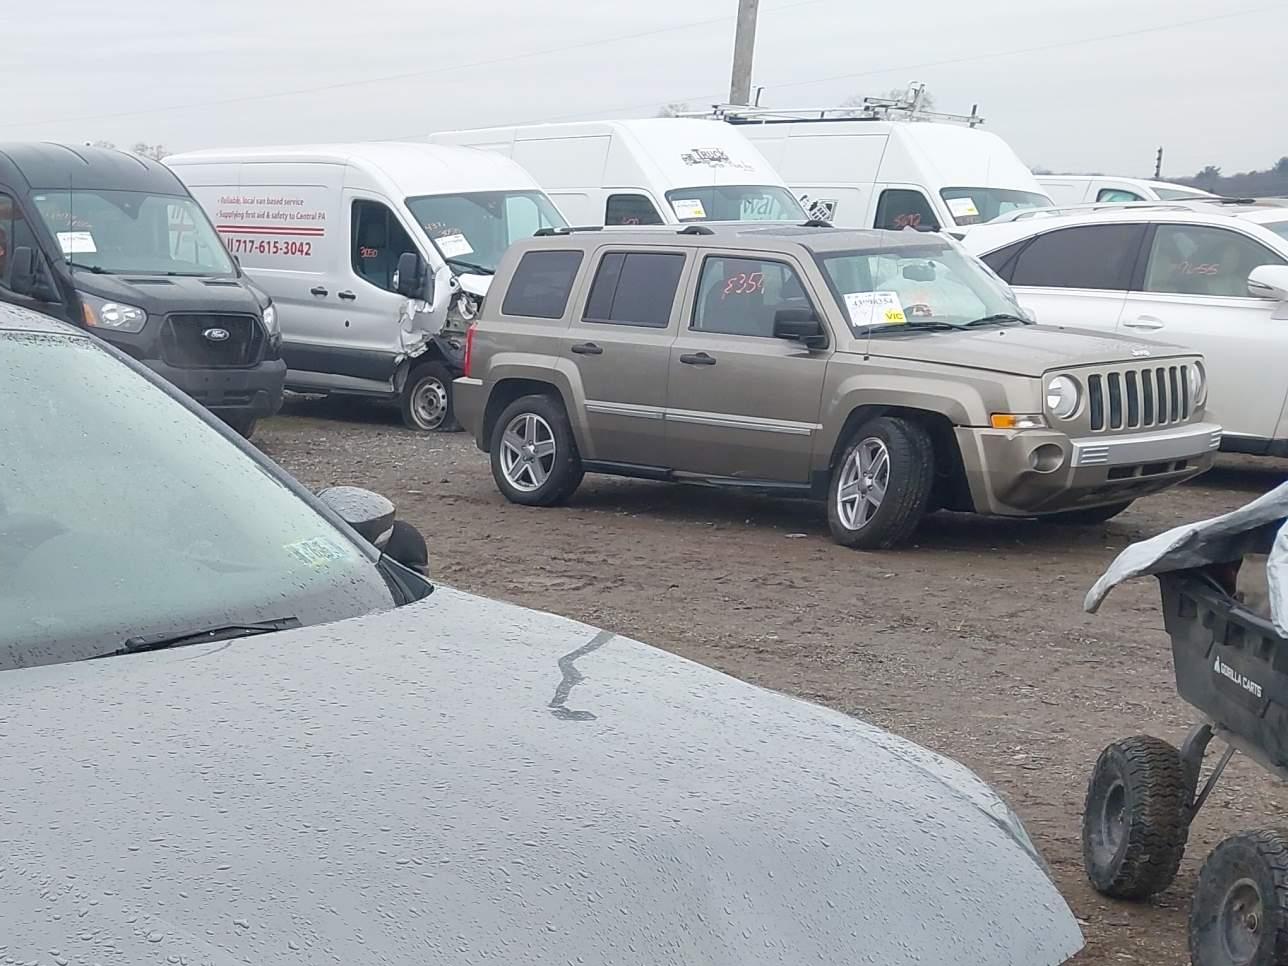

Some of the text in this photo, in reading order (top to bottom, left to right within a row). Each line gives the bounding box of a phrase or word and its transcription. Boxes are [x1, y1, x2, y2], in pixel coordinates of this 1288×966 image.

[266, 197, 283, 206] based
[284, 197, 304, 206] service
[257, 211, 265, 219] aid
[272, 211, 288, 221] safety
[296, 211, 317, 220] Central
[317, 212, 326, 220] PA
[235, 239, 312, 256] 717-615-3042
[885, 312, 904, 321] VIC
[1242, 676, 1263, 698] CARTS
